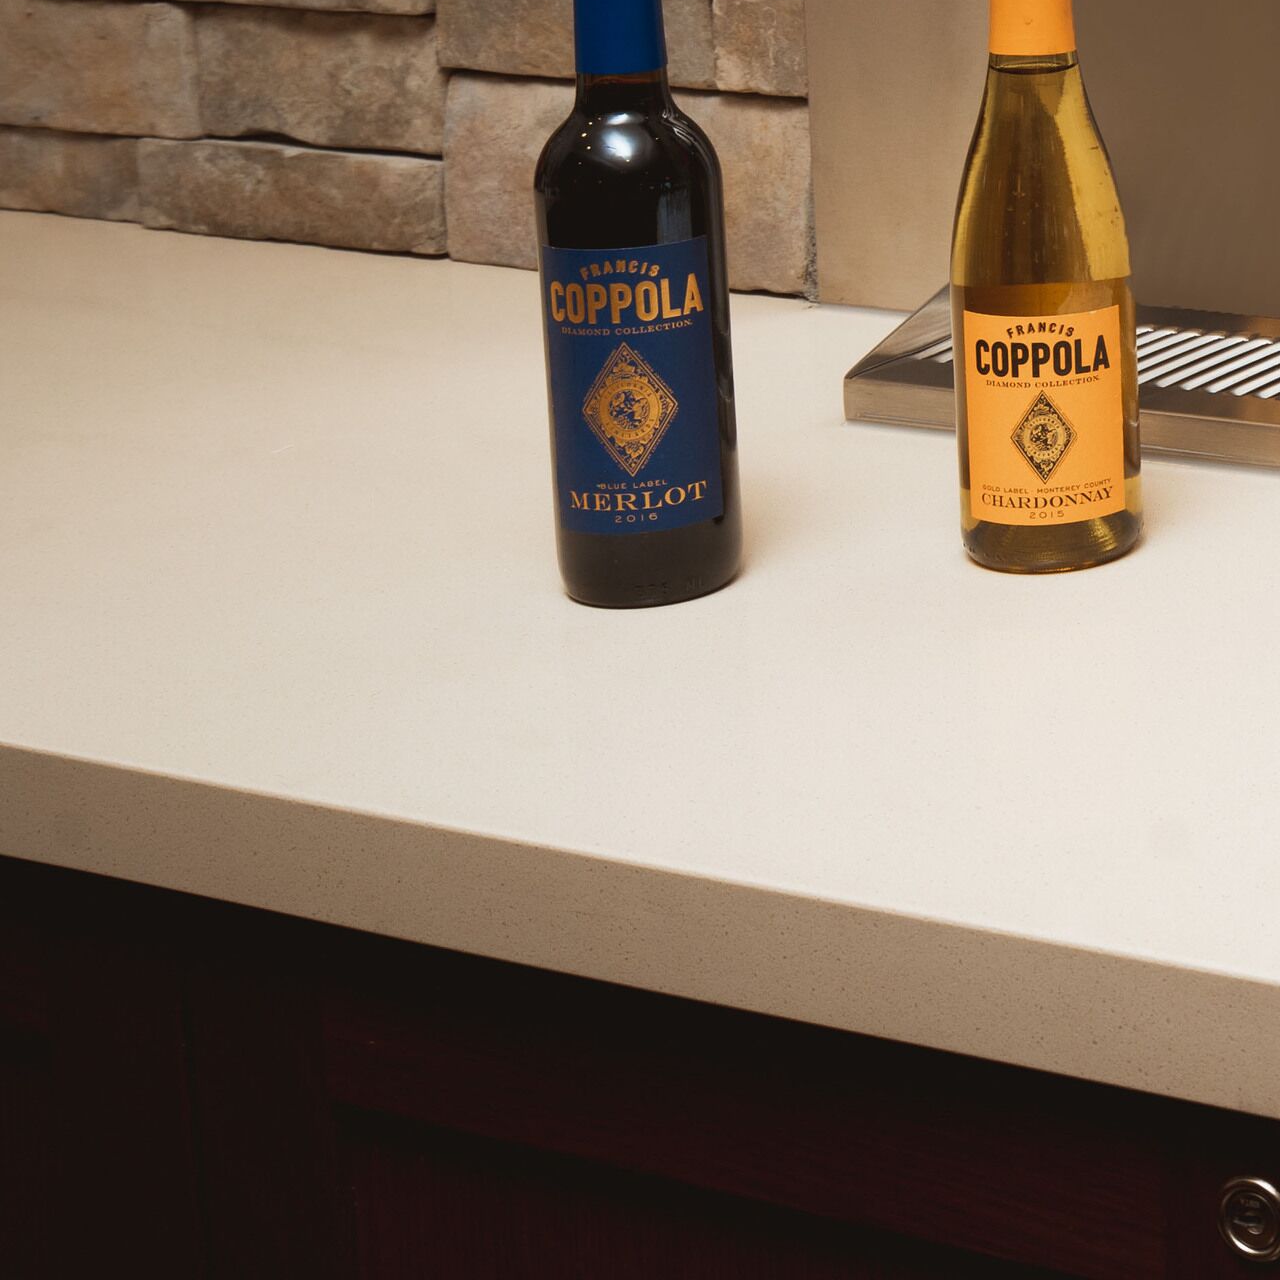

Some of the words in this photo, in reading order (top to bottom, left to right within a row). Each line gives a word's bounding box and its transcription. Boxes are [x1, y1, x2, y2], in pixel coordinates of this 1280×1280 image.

[580, 259, 660, 281] FRANCIS
[550, 272, 704, 325] COPPOLA
[561, 326, 610, 336] DIAMOND
[615, 318, 693, 336] COLLECTION
[1006, 321, 1075, 339] FRANCIS
[975, 334, 1111, 379] COPPOLA
[986, 379, 1031, 389] DIAMOND
[1034, 375, 1100, 389] COLLECTION
[570, 479, 707, 512] MERLOT
[982, 484, 1000, 493] GOLD
[1036, 484, 1081, 494] MONTEREY
[1084, 478, 1112, 489] COUNTY
[981, 486, 1113, 509] CHARDONNAY
[1029, 510, 1065, 520] 2015
